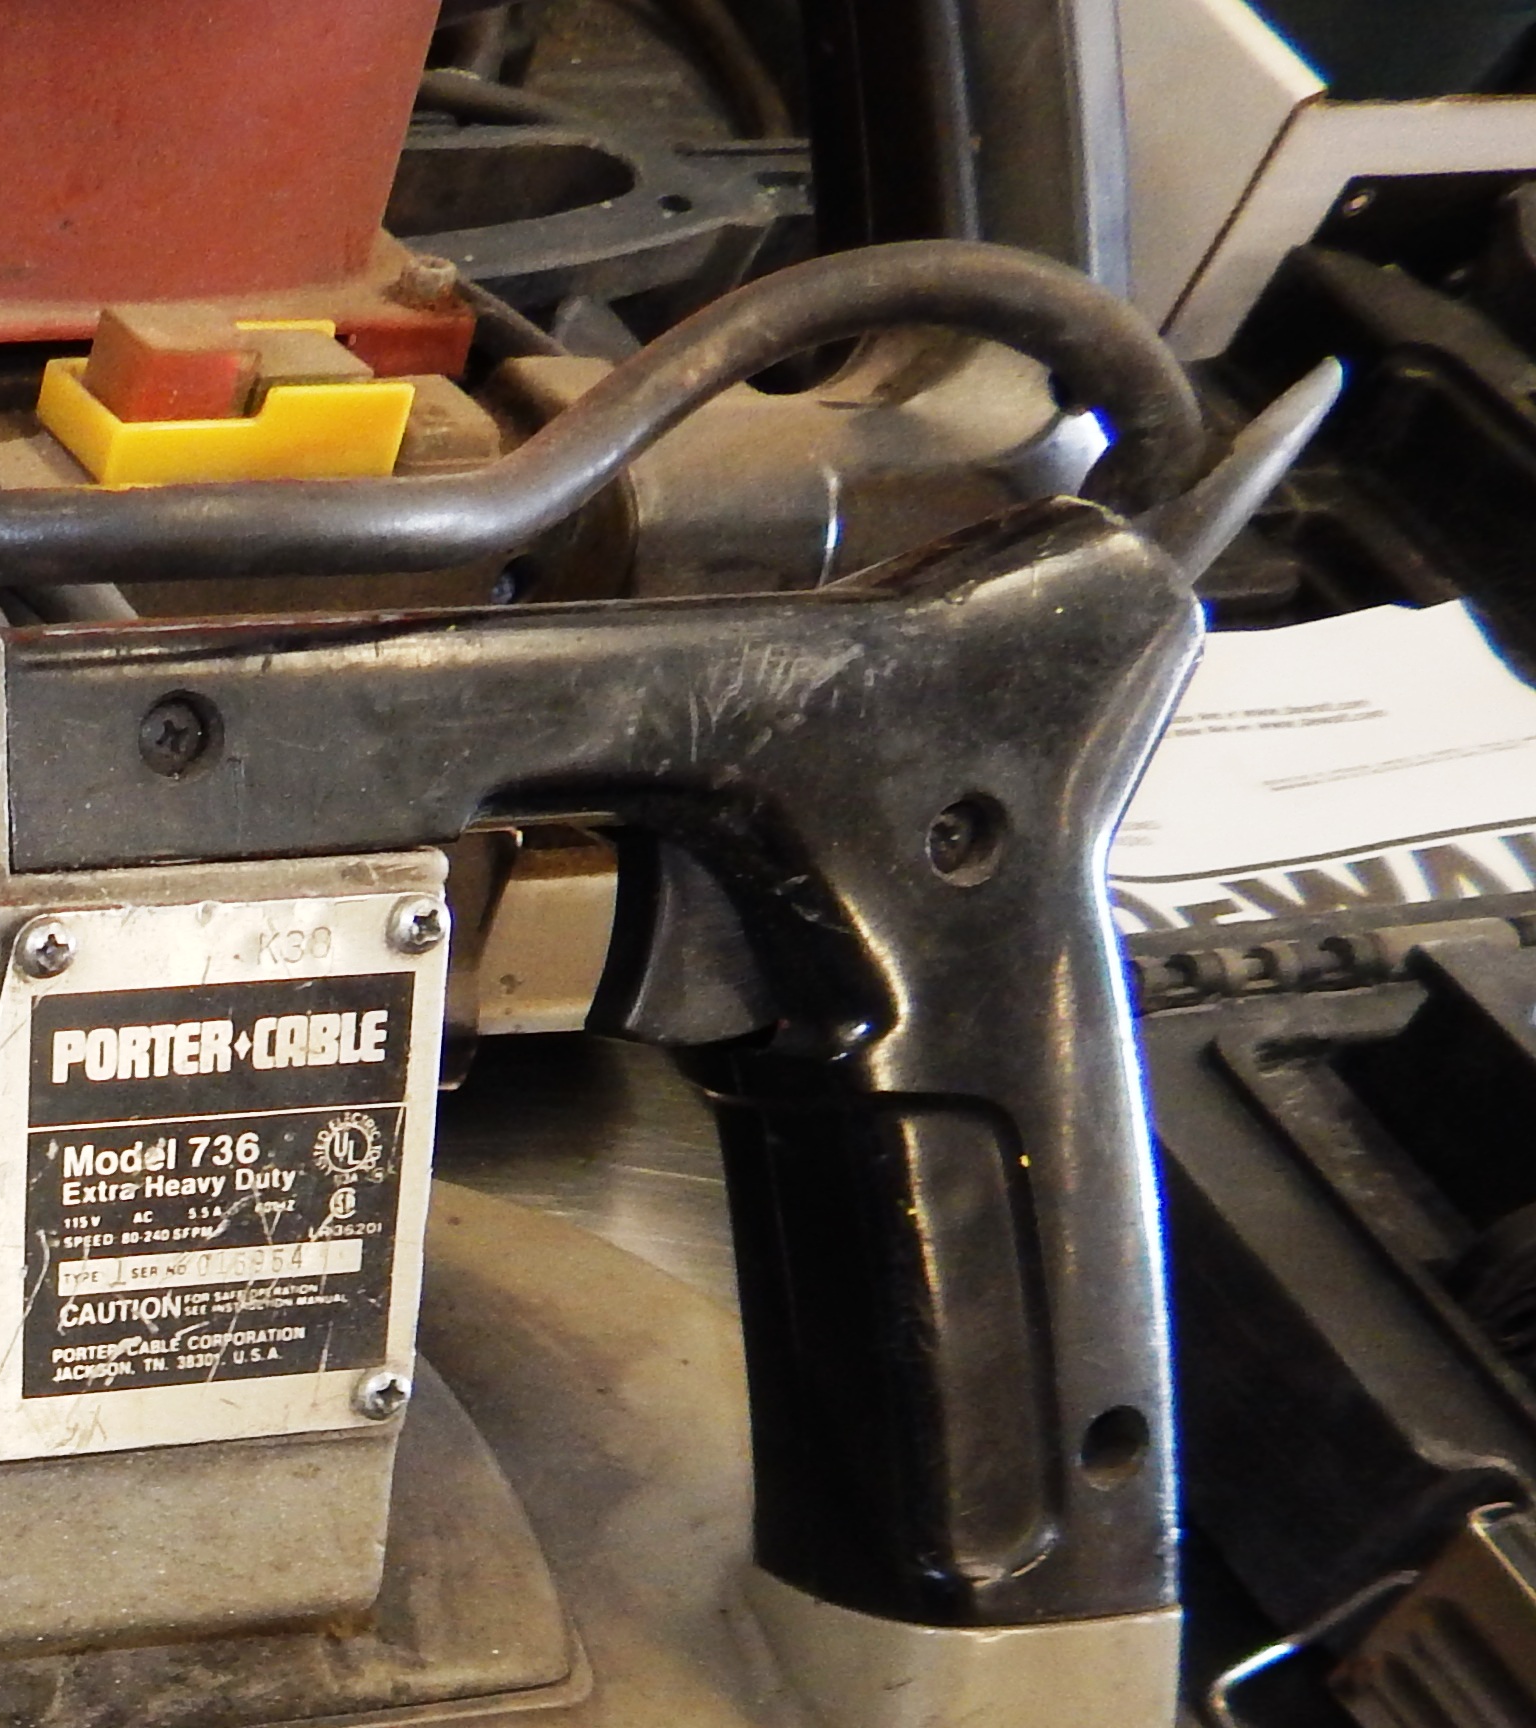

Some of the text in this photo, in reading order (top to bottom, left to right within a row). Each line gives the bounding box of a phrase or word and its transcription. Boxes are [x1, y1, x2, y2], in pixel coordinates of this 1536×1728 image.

[62, 1132, 260, 1180] Model 736
[62, 1169, 297, 1207] Extra Heavy Duty
[133, 1211, 154, 1224] AC
[63, 1233, 114, 1249] SPEED
[121, 1229, 169, 1245] 80-240
[63, 1270, 100, 1284] TYPE
[131, 1265, 159, 1280] SER
[184, 1291, 209, 1304] FOR
[60, 1295, 183, 1329] CAUTION
[184, 1305, 207, 1318] SEE
[187, 1326, 306, 1350] CORPORATION
